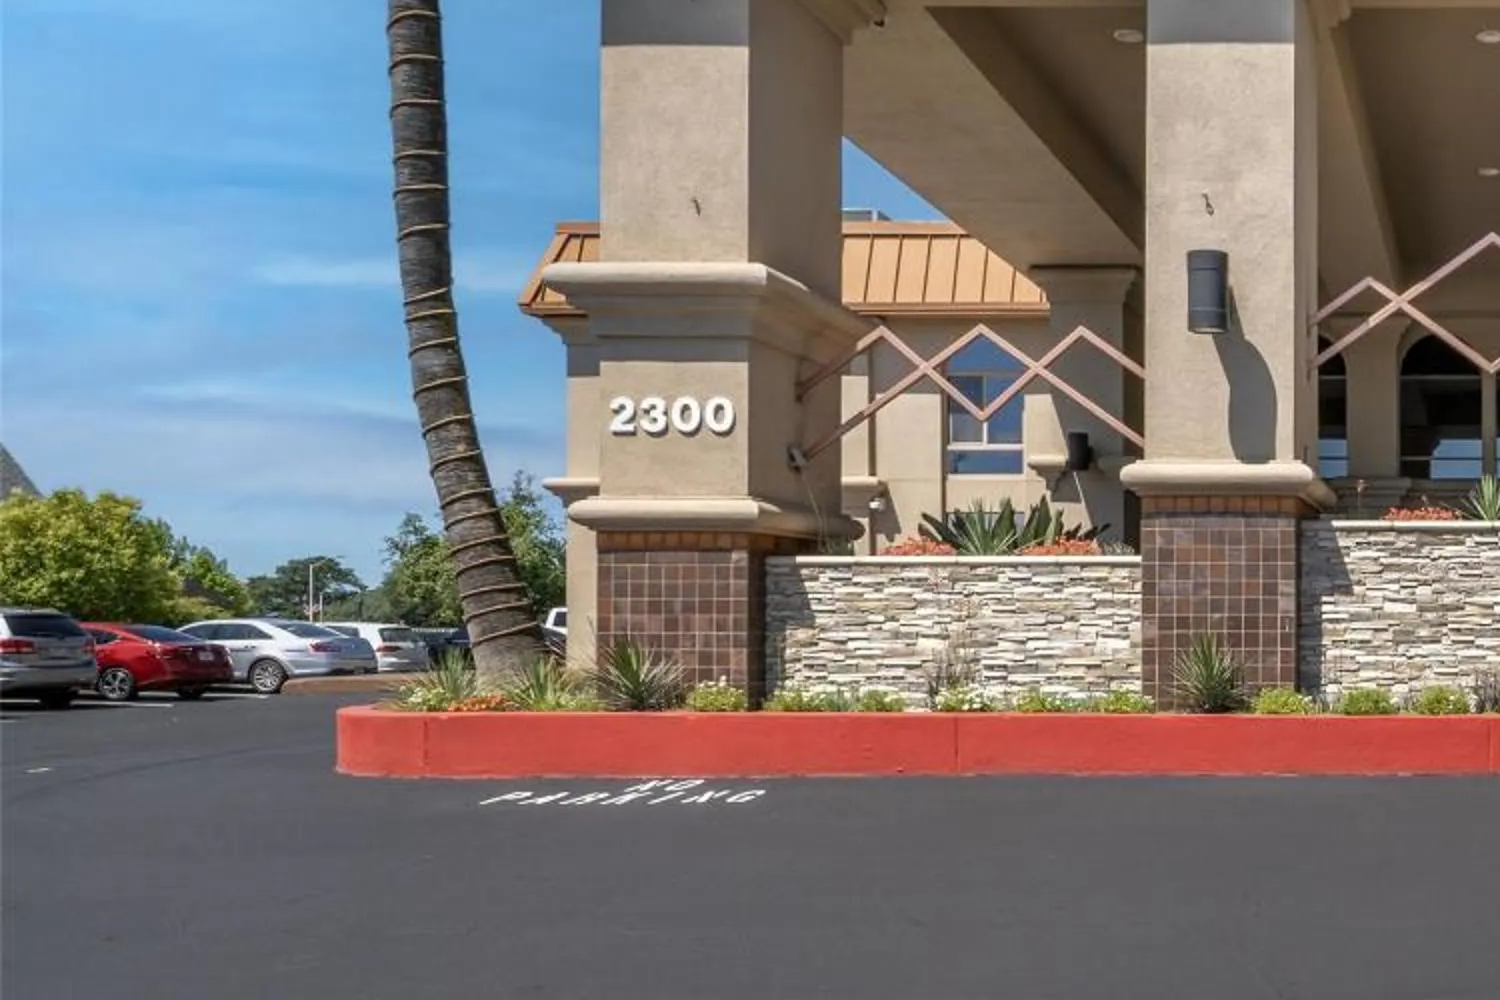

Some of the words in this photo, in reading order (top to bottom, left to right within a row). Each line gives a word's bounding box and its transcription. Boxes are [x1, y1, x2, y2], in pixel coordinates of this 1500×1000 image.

[609, 396, 735, 436] 2300
[623, 779, 705, 793] NO
[480, 790, 767, 805] PARKING
